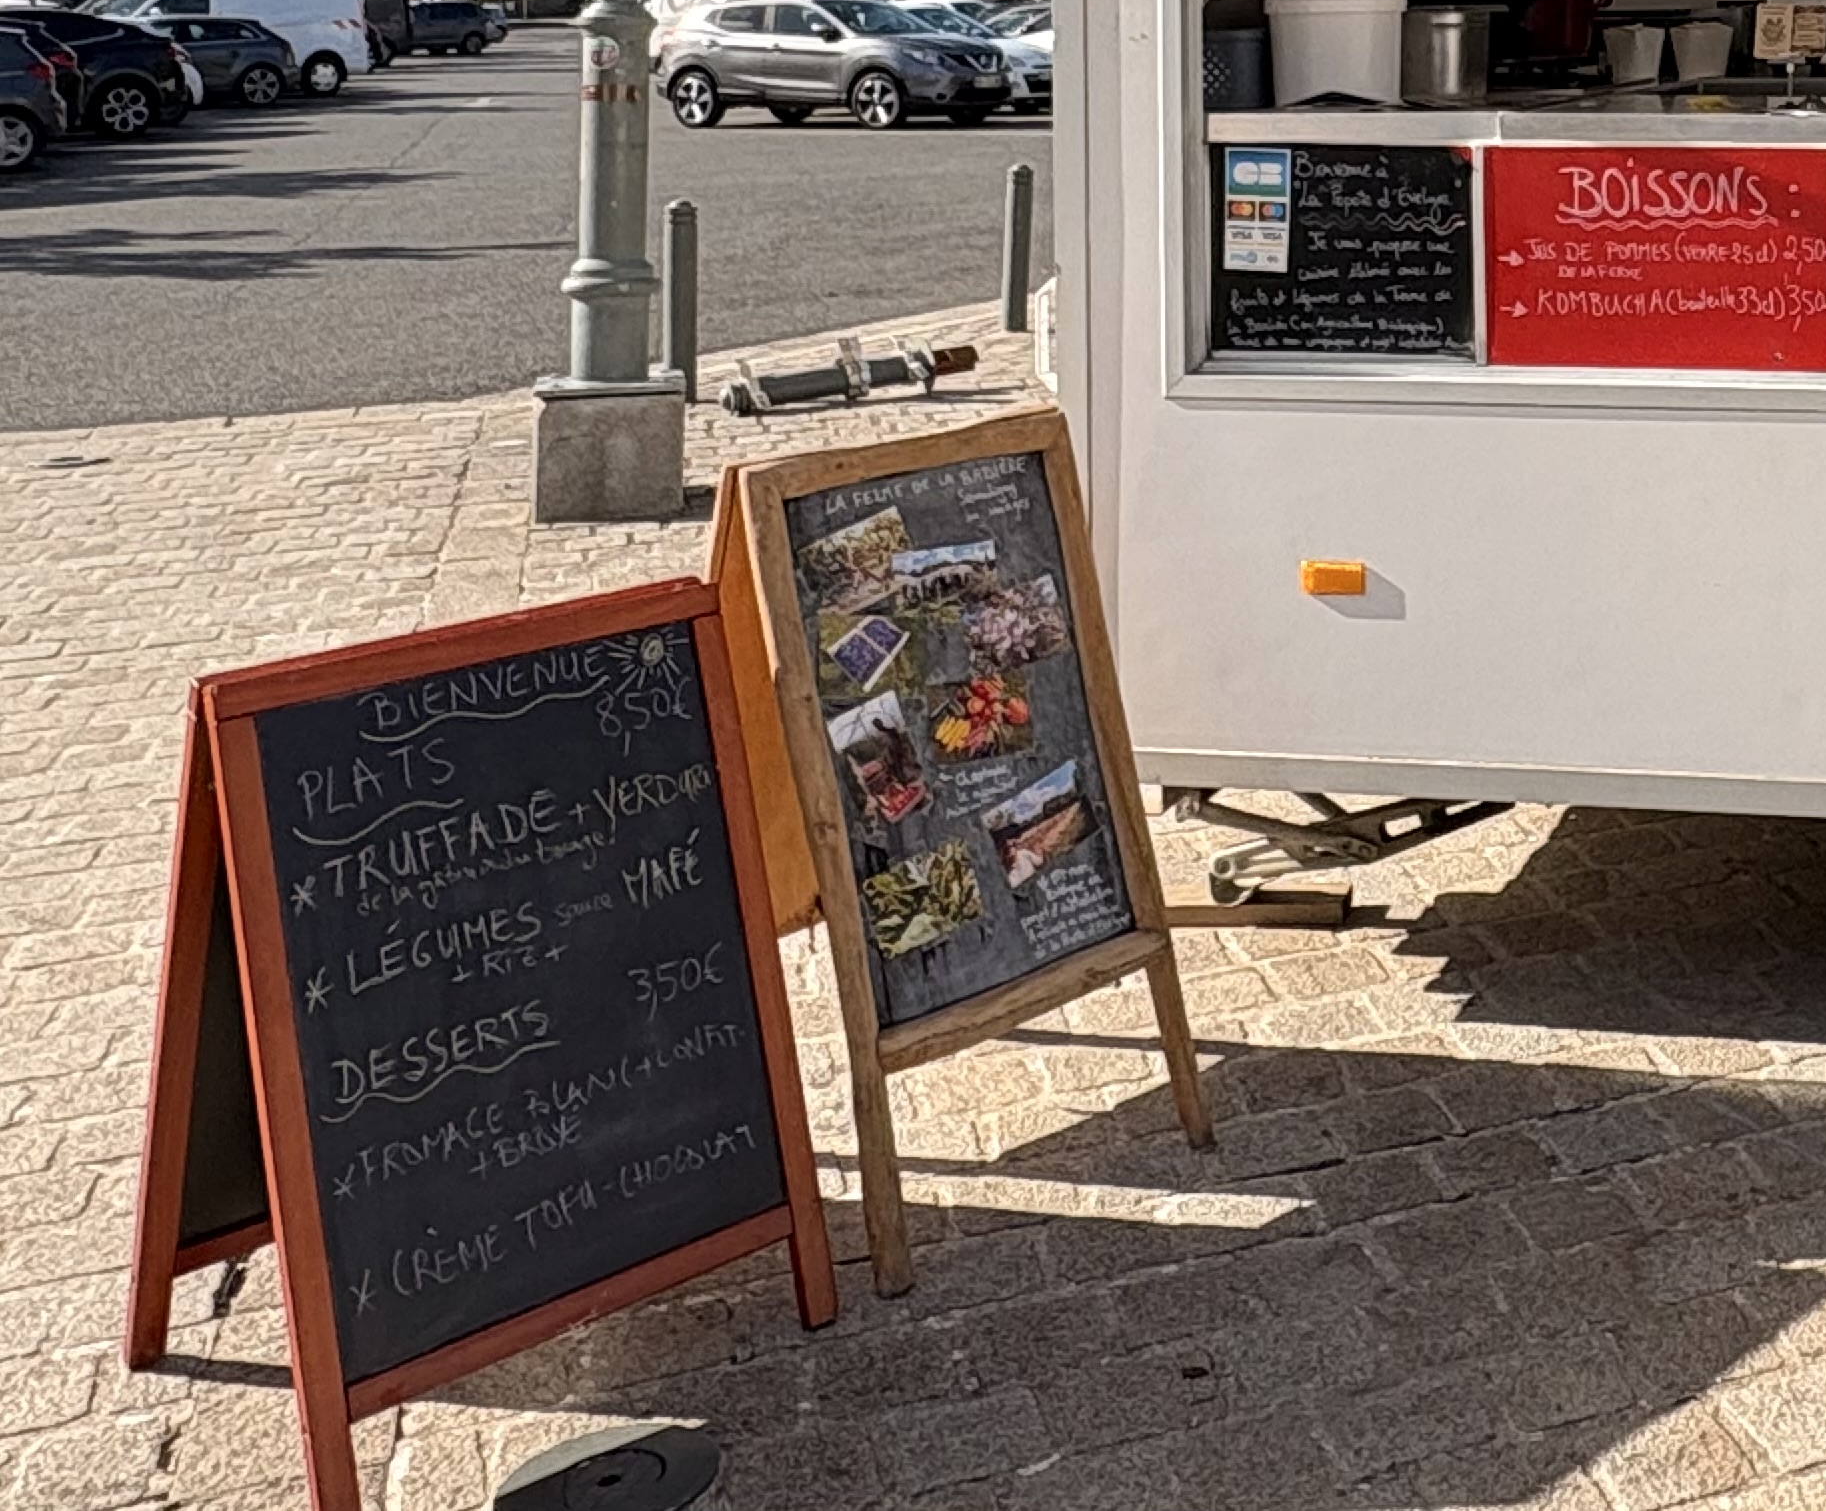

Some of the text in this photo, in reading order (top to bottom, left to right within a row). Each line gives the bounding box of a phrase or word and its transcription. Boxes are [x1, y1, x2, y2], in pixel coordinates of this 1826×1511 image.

[1565, 242, 1592, 262] DE
[1606, 242, 1671, 262] POMMES
[1537, 287, 1665, 317] KOMBUCHA
[359, 647, 608, 730] BIENVENUE
[597, 678, 692, 756] 8,50€
[297, 738, 456, 820] PLATS
[325, 790, 558, 897] TRUFFADE
[347, 903, 541, 993] LÉGUMES
[622, 827, 704, 908] MAFÉ
[628, 943, 725, 1022] 3,50€
[332, 1000, 550, 1103] DESSERTS
[360, 1102, 503, 1188] FROMAGE
[391, 1226, 507, 1296] CRÈME
